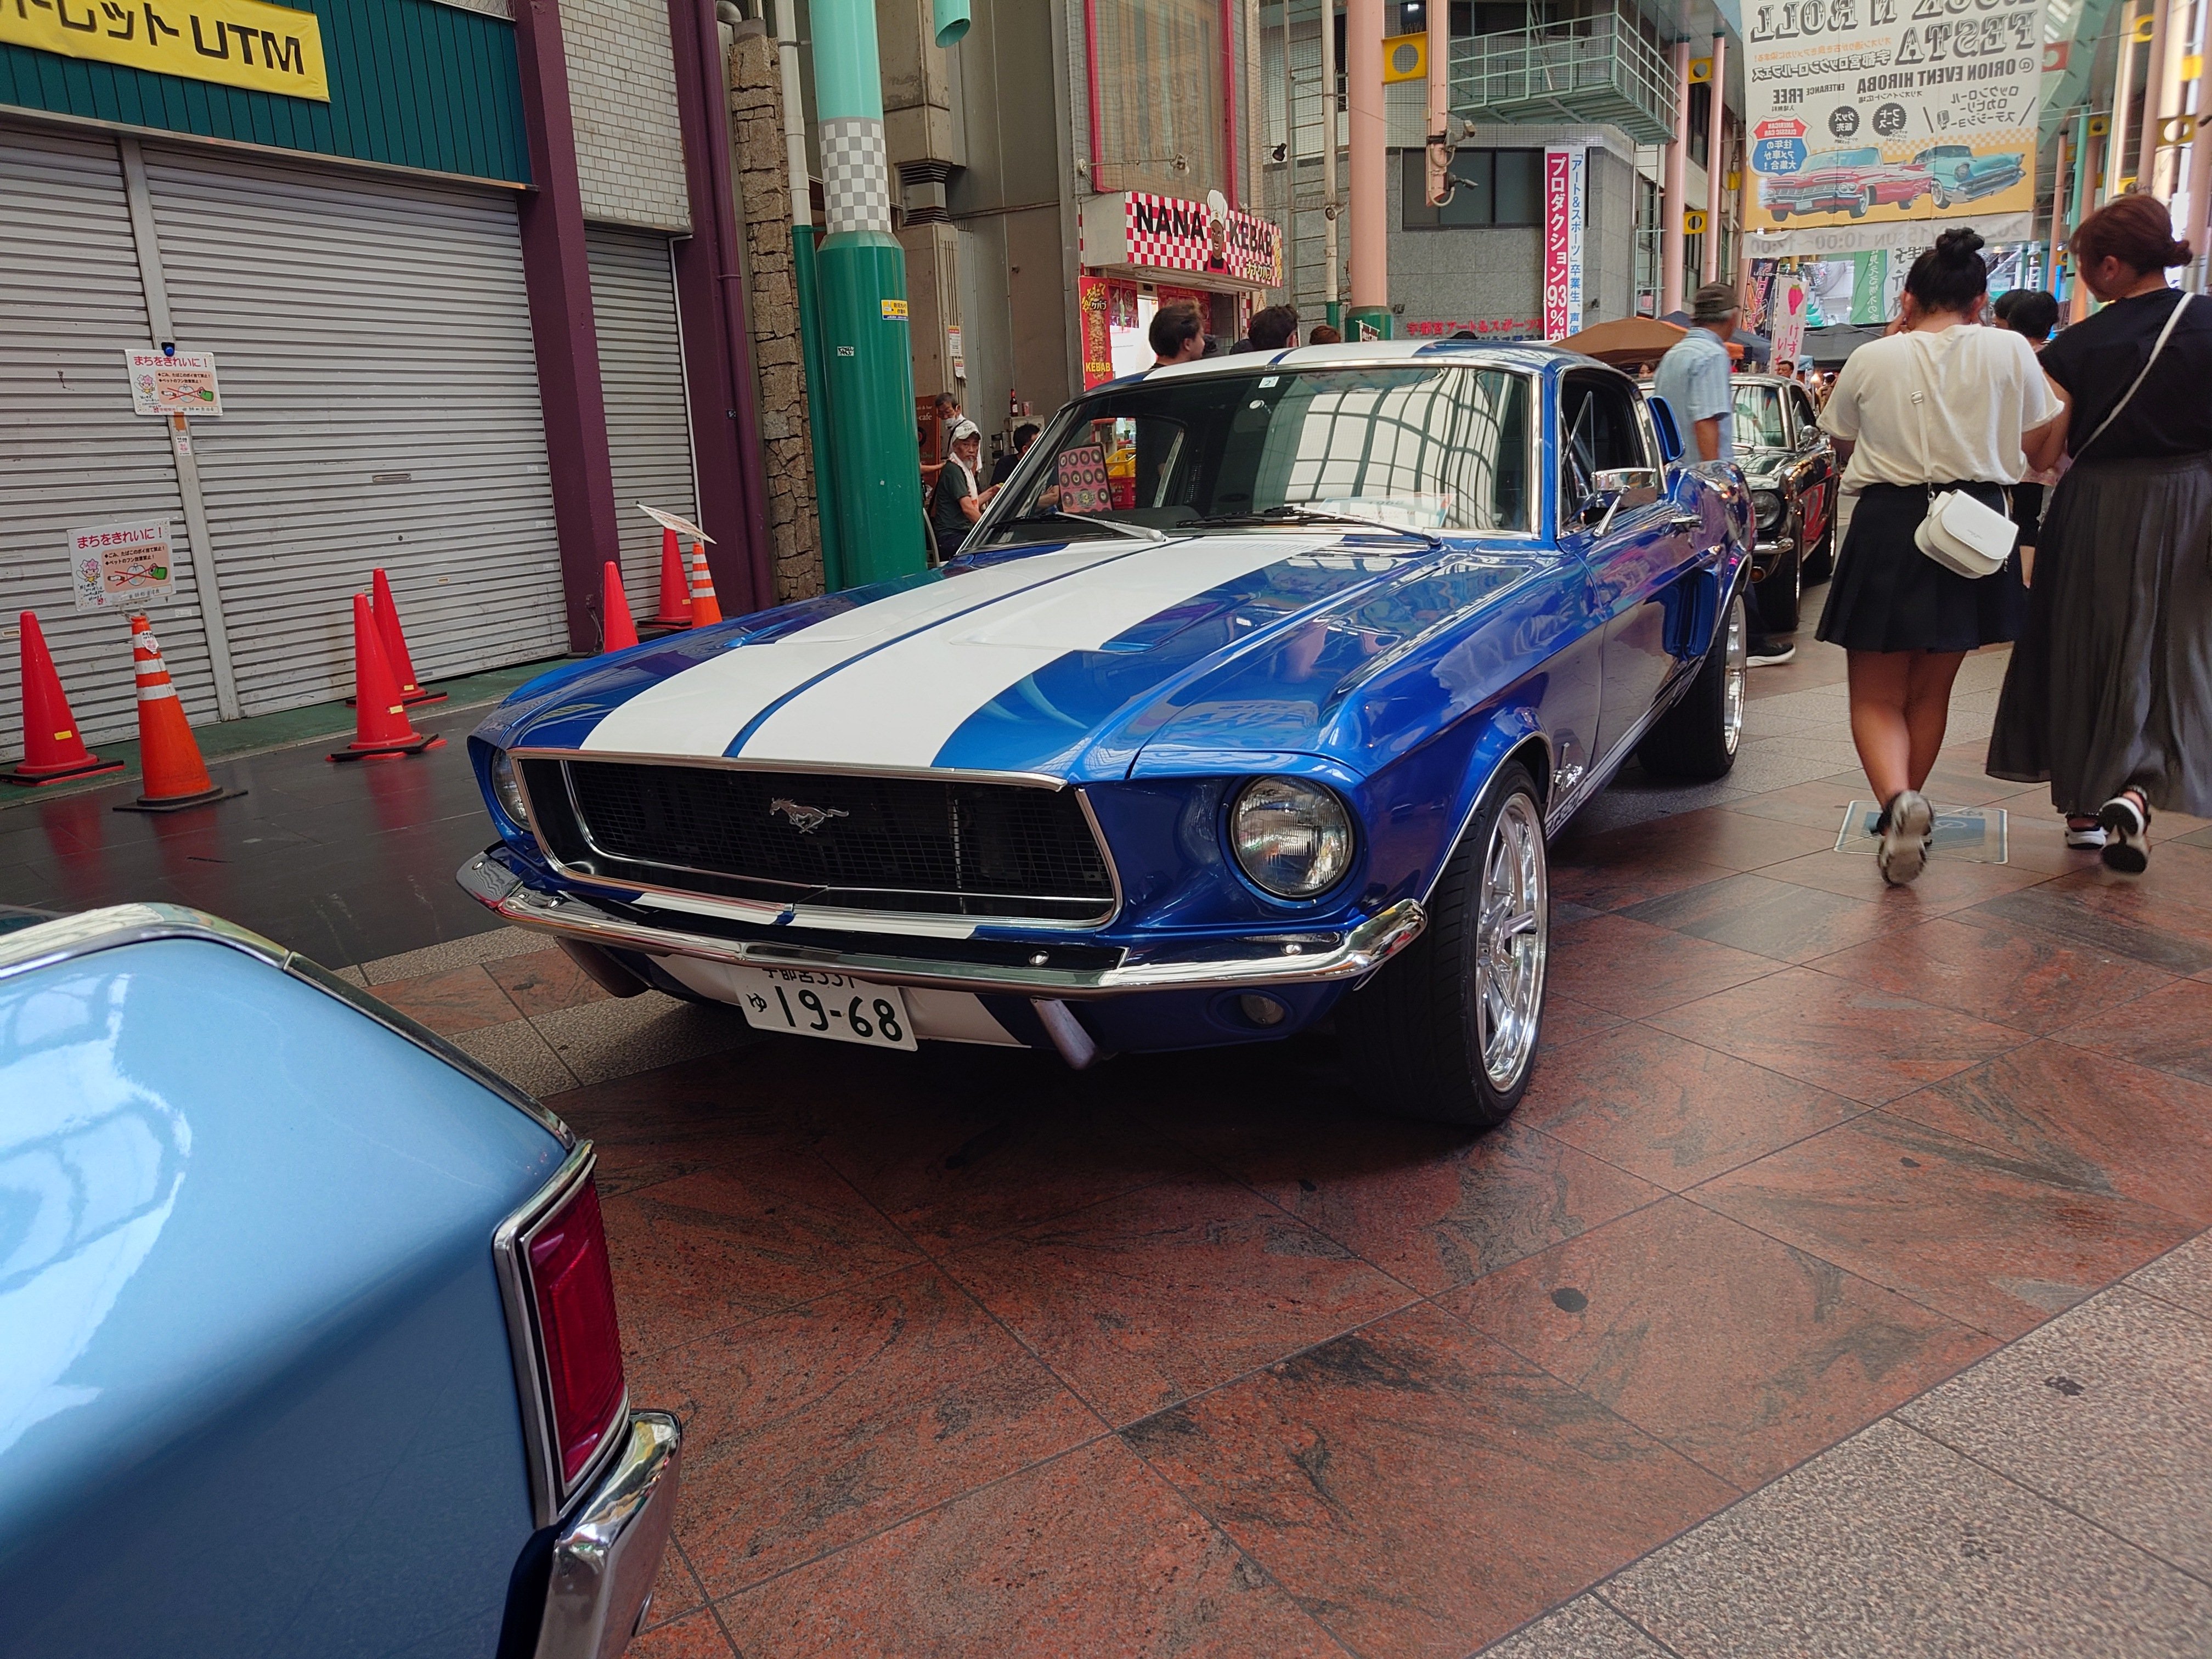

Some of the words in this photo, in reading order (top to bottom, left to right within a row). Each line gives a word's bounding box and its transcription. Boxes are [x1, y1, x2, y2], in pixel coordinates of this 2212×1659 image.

[190, 15, 304, 75] UTM
[1136, 201, 1205, 241] NANA
[1229, 219, 1272, 257] KEBAB
[1091, 300, 1107, 310] ケバブ
[133, 356, 208, 368] まちをきれいに！
[1085, 362, 1111, 373] KEBAB
[919, 412, 933, 421] cafe
[77, 527, 162, 549] まちをきれいに！
[746, 992, 768, 1013] ゆ
[774, 985, 903, 1042] 19-68
